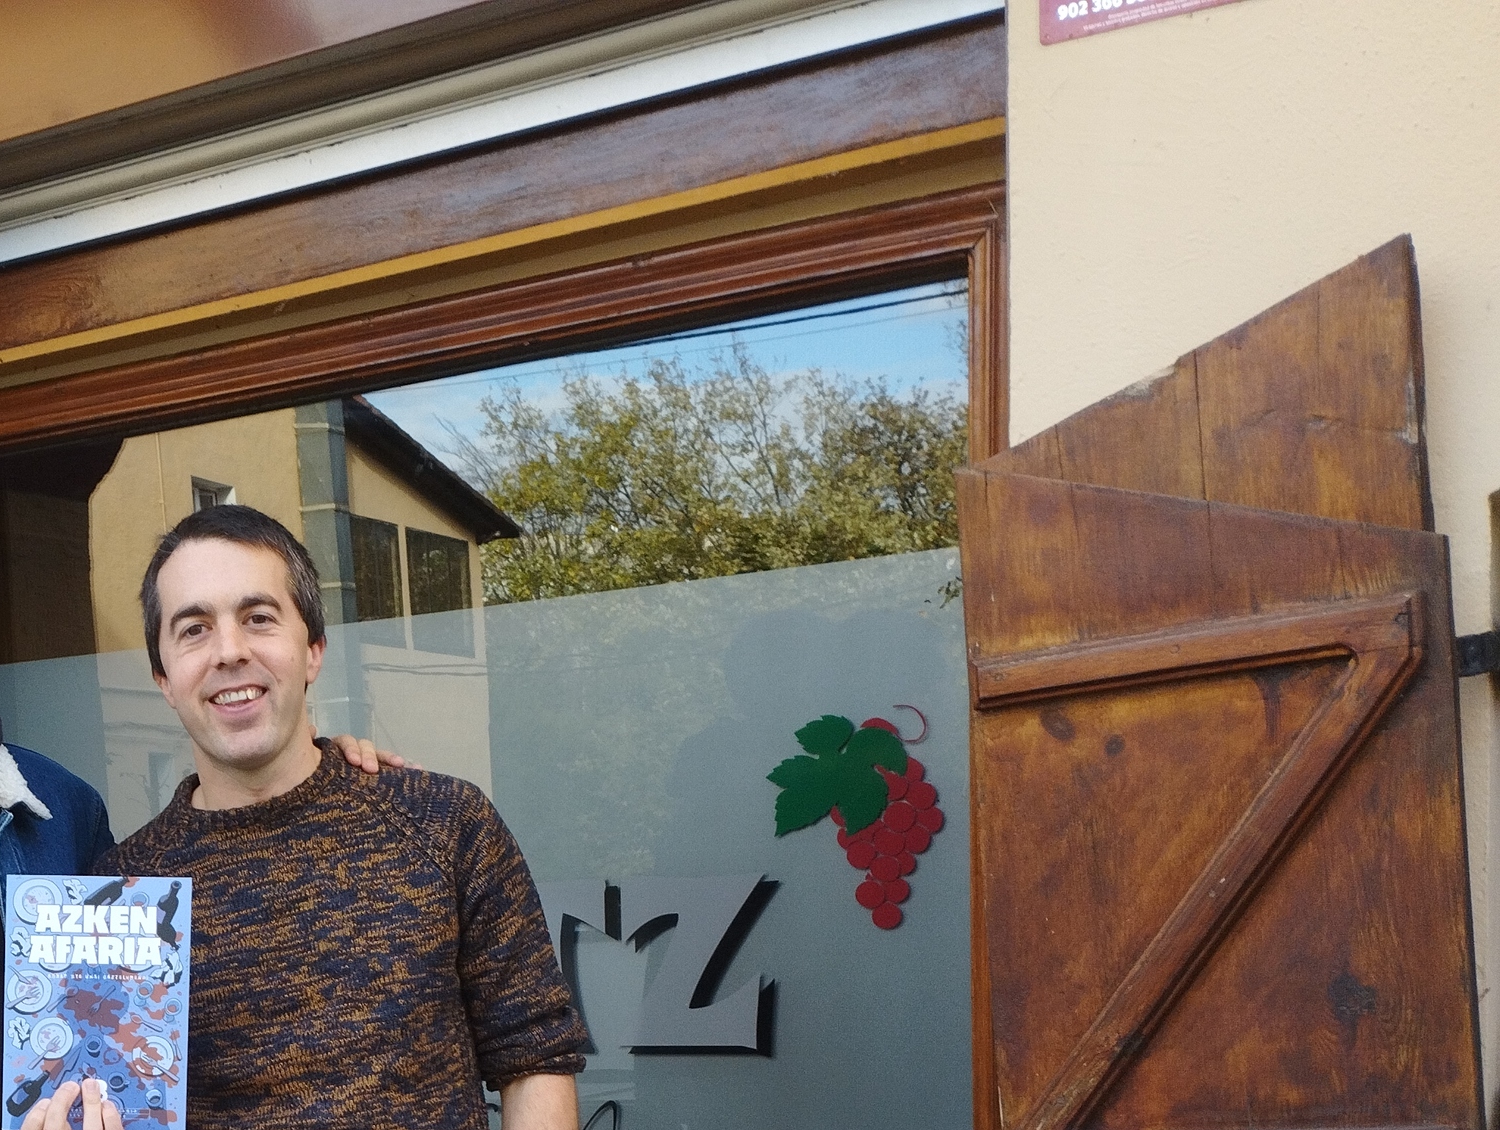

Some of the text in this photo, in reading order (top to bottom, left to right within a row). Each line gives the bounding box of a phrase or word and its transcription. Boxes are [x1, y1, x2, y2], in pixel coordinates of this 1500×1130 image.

[1057, 0, 1089, 20] 902
[35, 904, 158, 935] AZKEN
[28, 935, 162, 965] AFARIA
